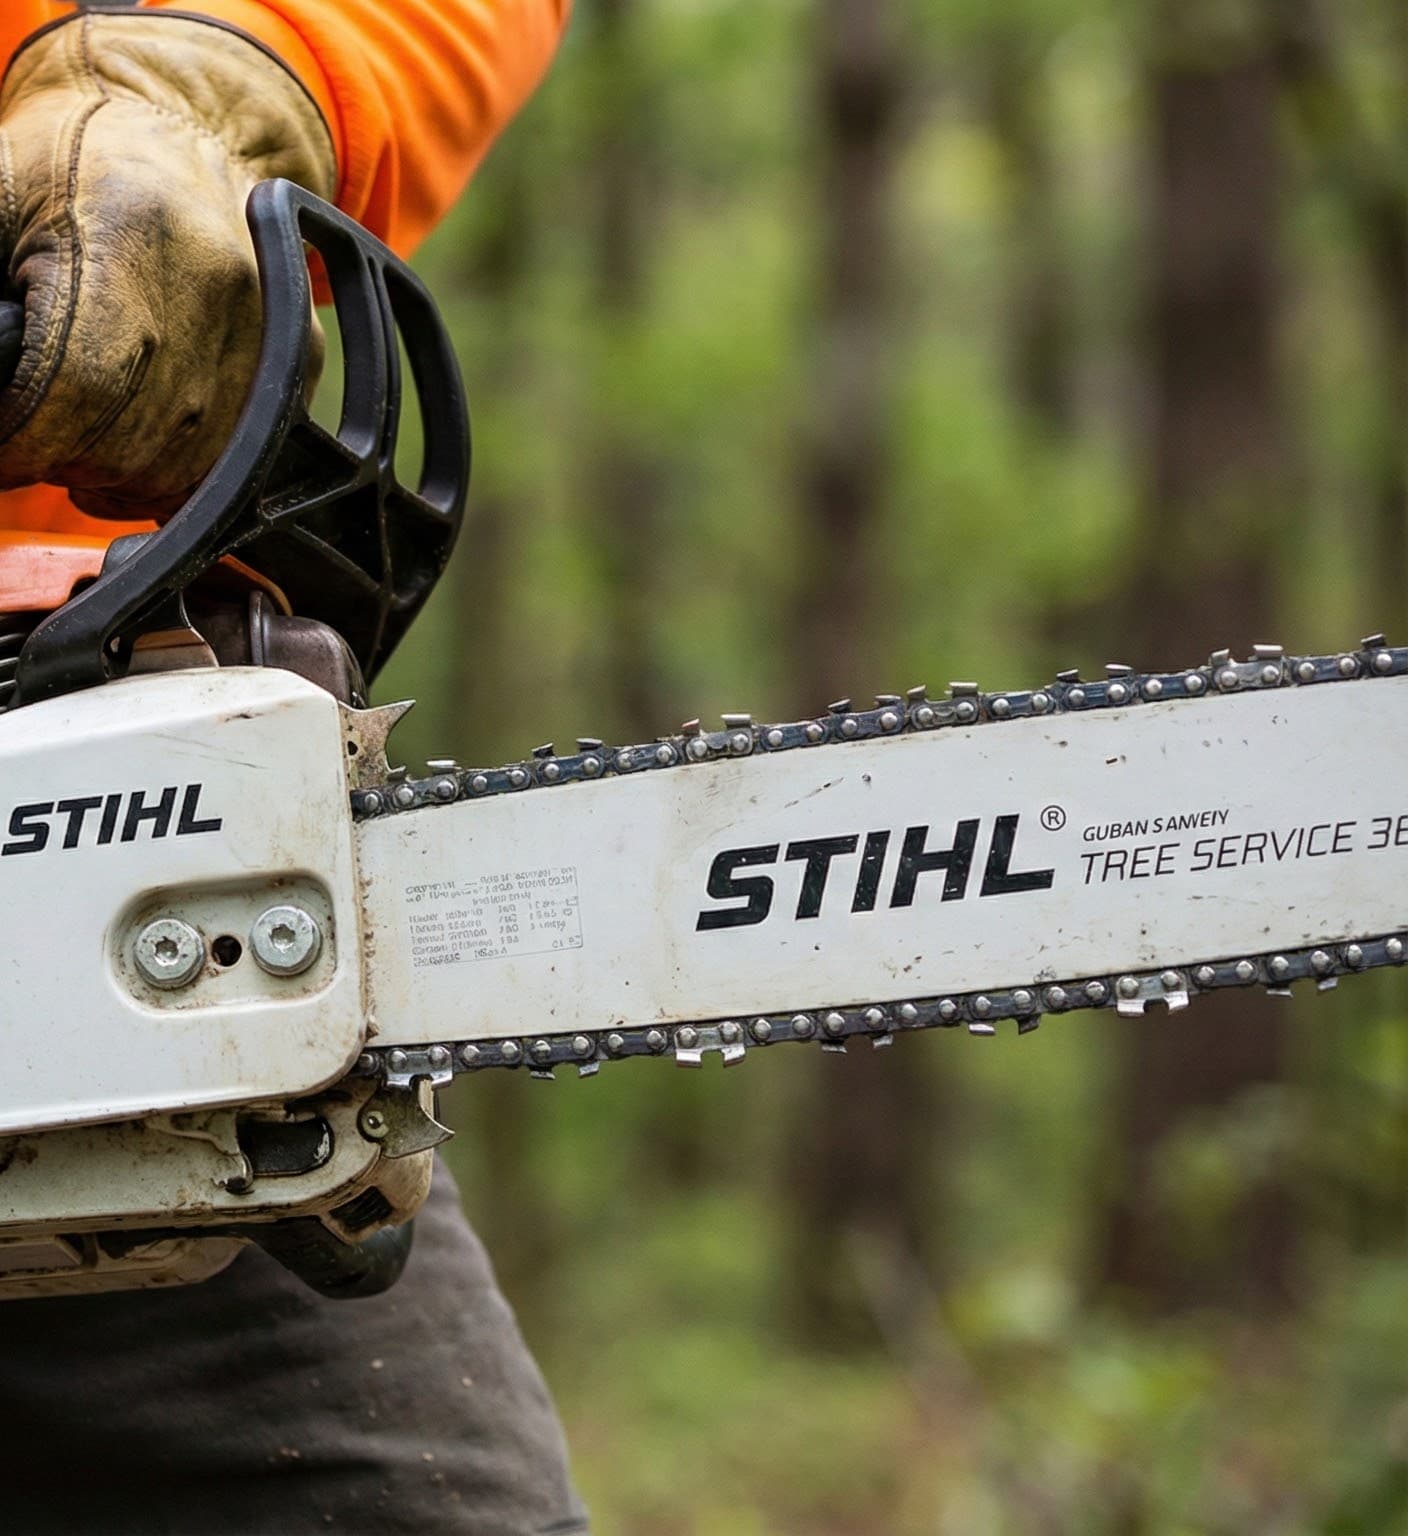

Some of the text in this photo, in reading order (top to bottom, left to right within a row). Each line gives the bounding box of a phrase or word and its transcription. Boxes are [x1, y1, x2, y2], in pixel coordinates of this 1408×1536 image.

[0, 783, 223, 857] STIHL
[1080, 842, 1181, 885] TREE
[1190, 820, 1358, 873] SERVICE
[1082, 819, 1149, 842] GUBAN
